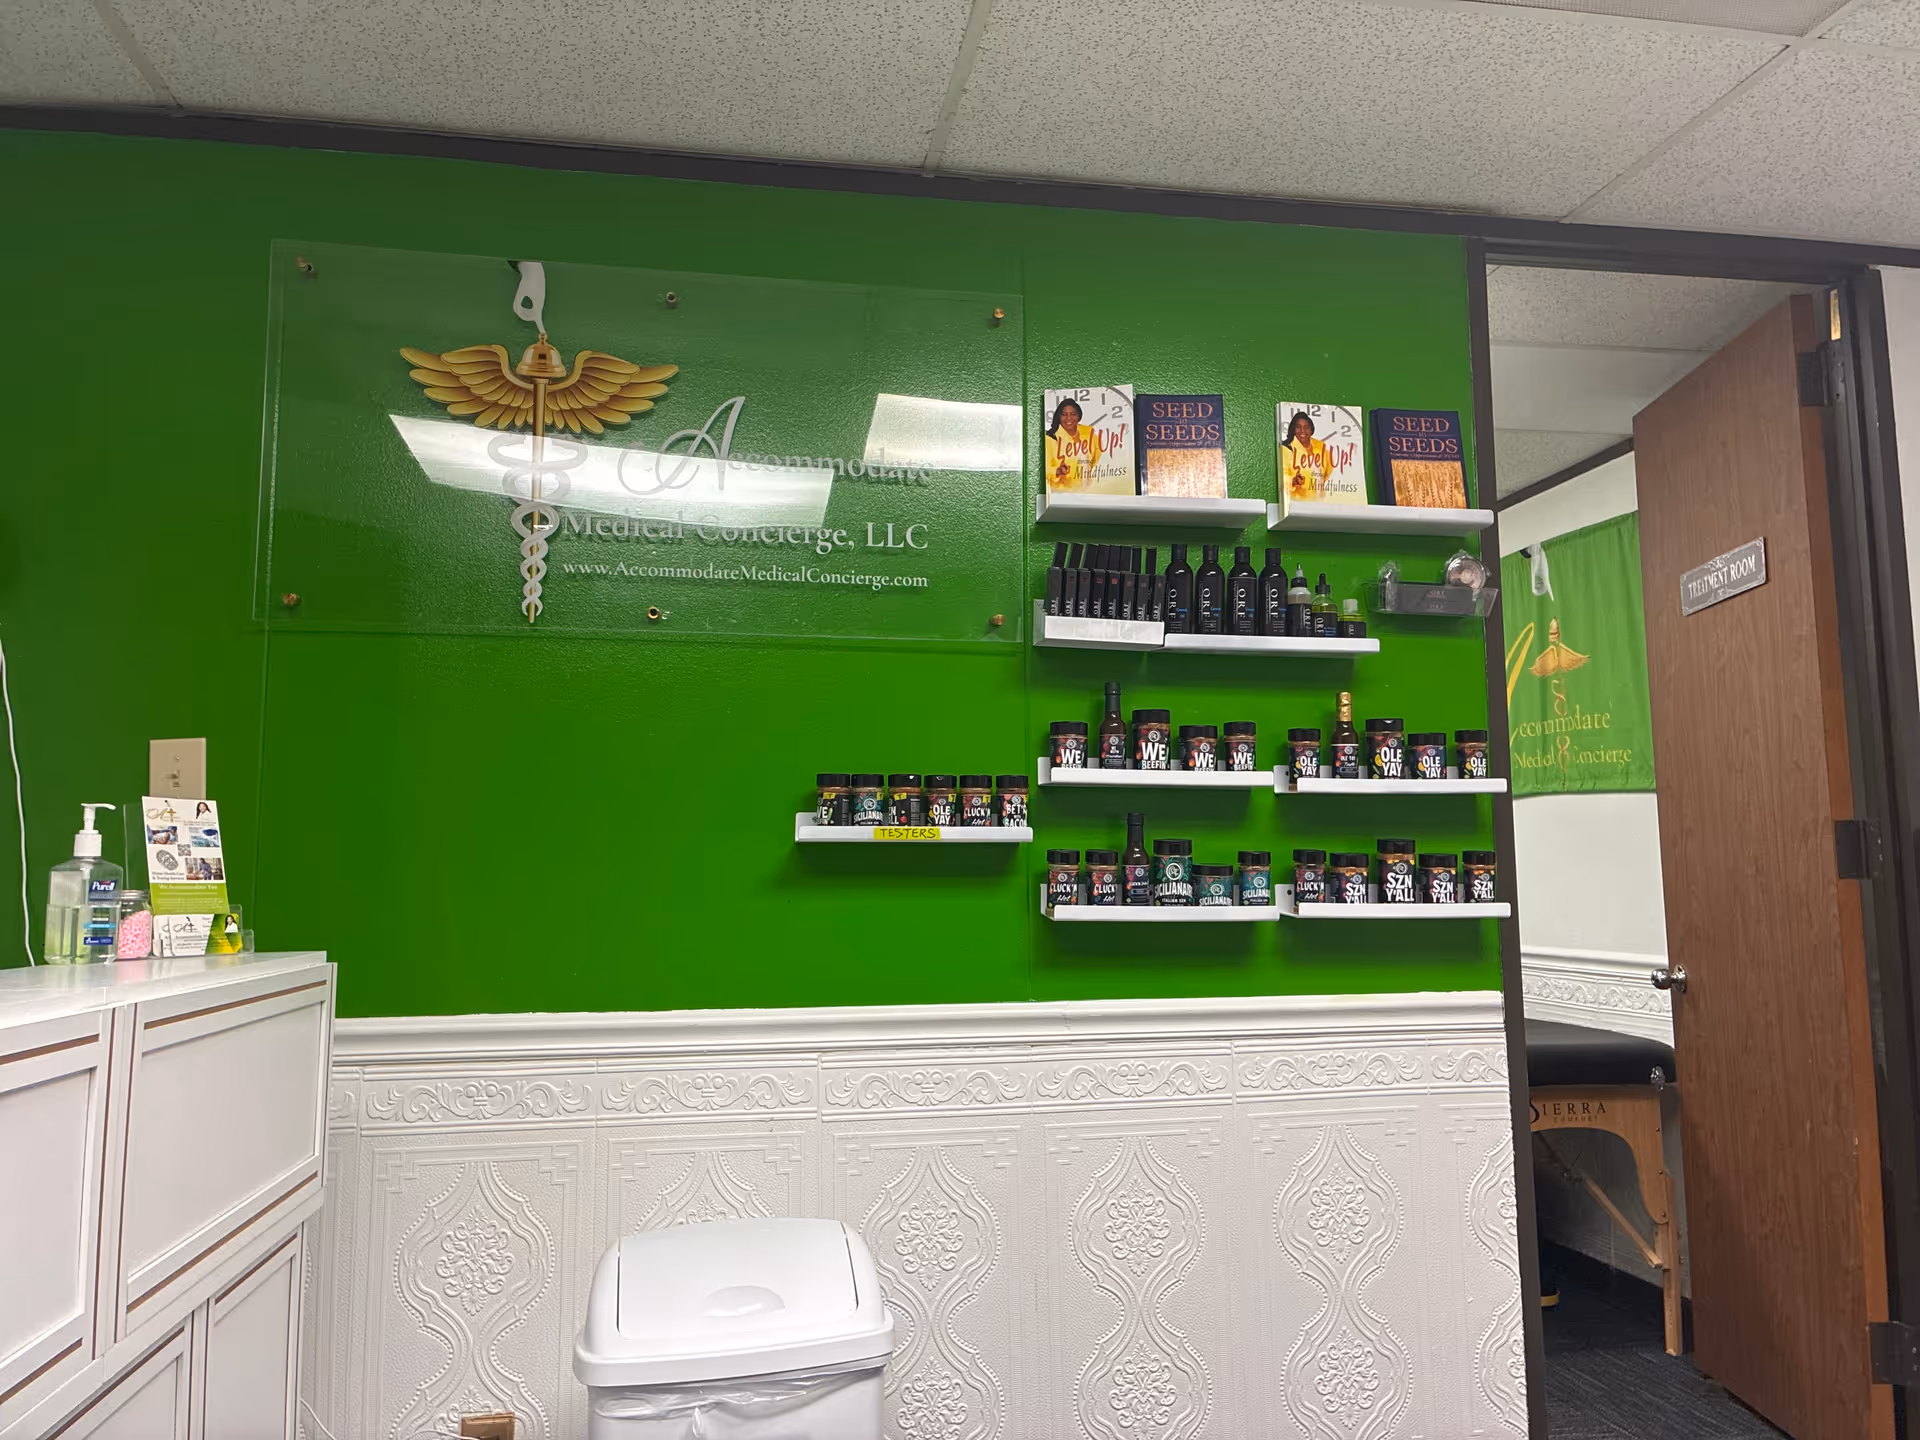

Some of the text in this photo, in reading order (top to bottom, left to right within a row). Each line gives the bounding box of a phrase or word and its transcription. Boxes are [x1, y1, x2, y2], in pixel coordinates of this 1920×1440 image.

[1152, 402, 1213, 418] SEED
[1393, 416, 1450, 432] SEED
[1146, 424, 1220, 441] SEEDS
[617, 396, 934, 495] Accommodate
[1056, 423, 1126, 461] Level Up!
[1389, 437, 1458, 454] SEEDS
[1292, 442, 1355, 475] Level Up!
[1073, 464, 1127, 483] Mindfulness
[1307, 477, 1358, 496] Mindfulness
[563, 510, 929, 555] Medical Concierge, LLC
[563, 560, 929, 590] www.AccommodateMedicalConcierge.com
[1688, 554, 1756, 600] TREATMENT ROOM
[1061, 749, 1082, 764] WE
[1141, 742, 1166, 760] WE
[1233, 752, 1252, 764] WE
[1380, 747, 1402, 762] OLE
[1194, 752, 1214, 768] WE
[1300, 756, 1317, 766] OLE
[1422, 756, 1440, 768] OLE
[1470, 757, 1486, 768] OLE
[1300, 766, 1317, 776] YAY
[1382, 762, 1402, 776] YAY
[1424, 768, 1442, 778] YAY
[1472, 768, 1486, 776] YAY
[932, 804, 950, 815] OLE
[933, 814, 950, 824] YAY
[880, 828, 936, 839] TESTERS
[1386, 872, 1412, 889] SZN
[1432, 880, 1454, 894] SZN
[1474, 880, 1494, 891] SZN
[1346, 882, 1366, 896] SZN
[1386, 888, 1414, 902] Y'ALL
[1472, 890, 1494, 898] Y'ALL
[1432, 892, 1456, 903] Y'ALL
